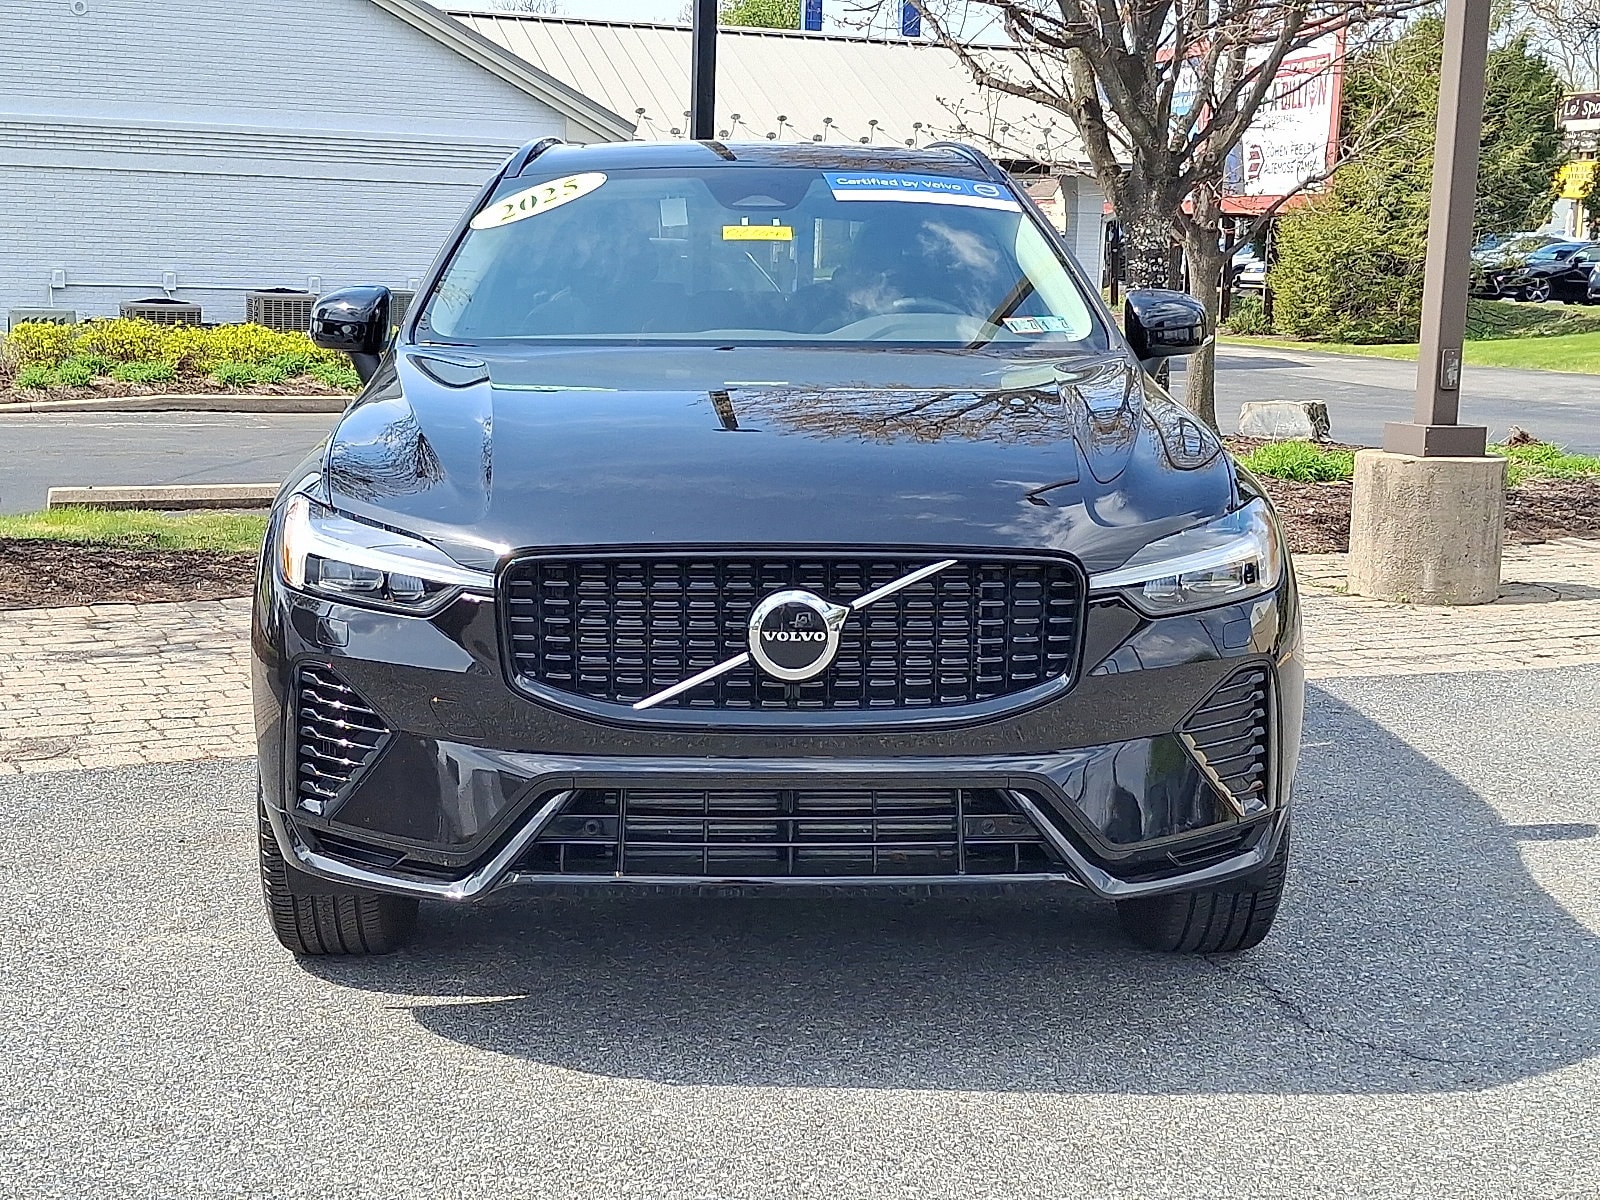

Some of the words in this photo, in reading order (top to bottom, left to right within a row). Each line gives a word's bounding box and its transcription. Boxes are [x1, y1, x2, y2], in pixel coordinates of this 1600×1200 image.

[836, 177, 899, 187] Certified
[902, 179, 920, 189] by
[921, 180, 962, 191] Volvo
[500, 178, 579, 221] 2025
[762, 631, 827, 642] VOLVO
